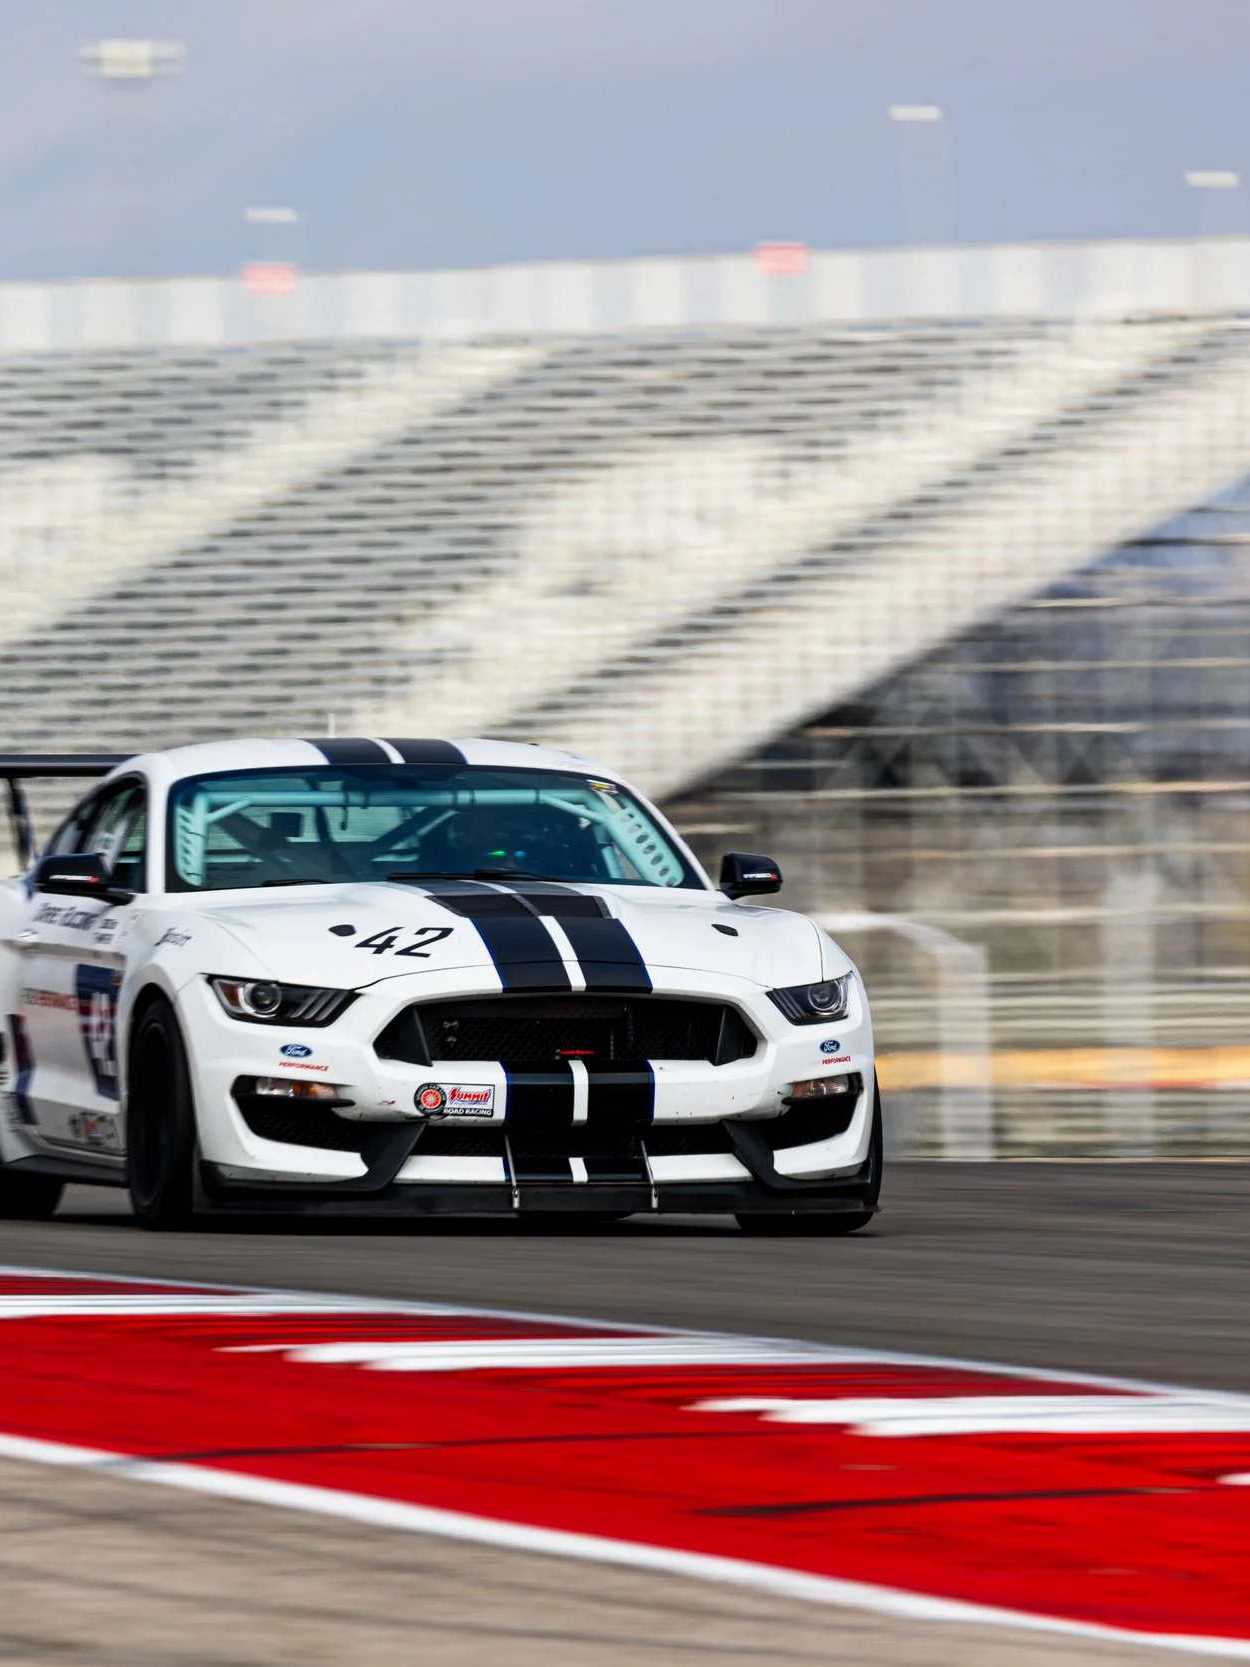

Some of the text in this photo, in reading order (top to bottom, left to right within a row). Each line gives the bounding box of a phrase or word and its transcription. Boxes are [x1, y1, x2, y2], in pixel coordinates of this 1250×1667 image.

[354, 927, 454, 958] 42
[443, 1107, 464, 1115] ROAD
[465, 1108, 492, 1116] RACING
